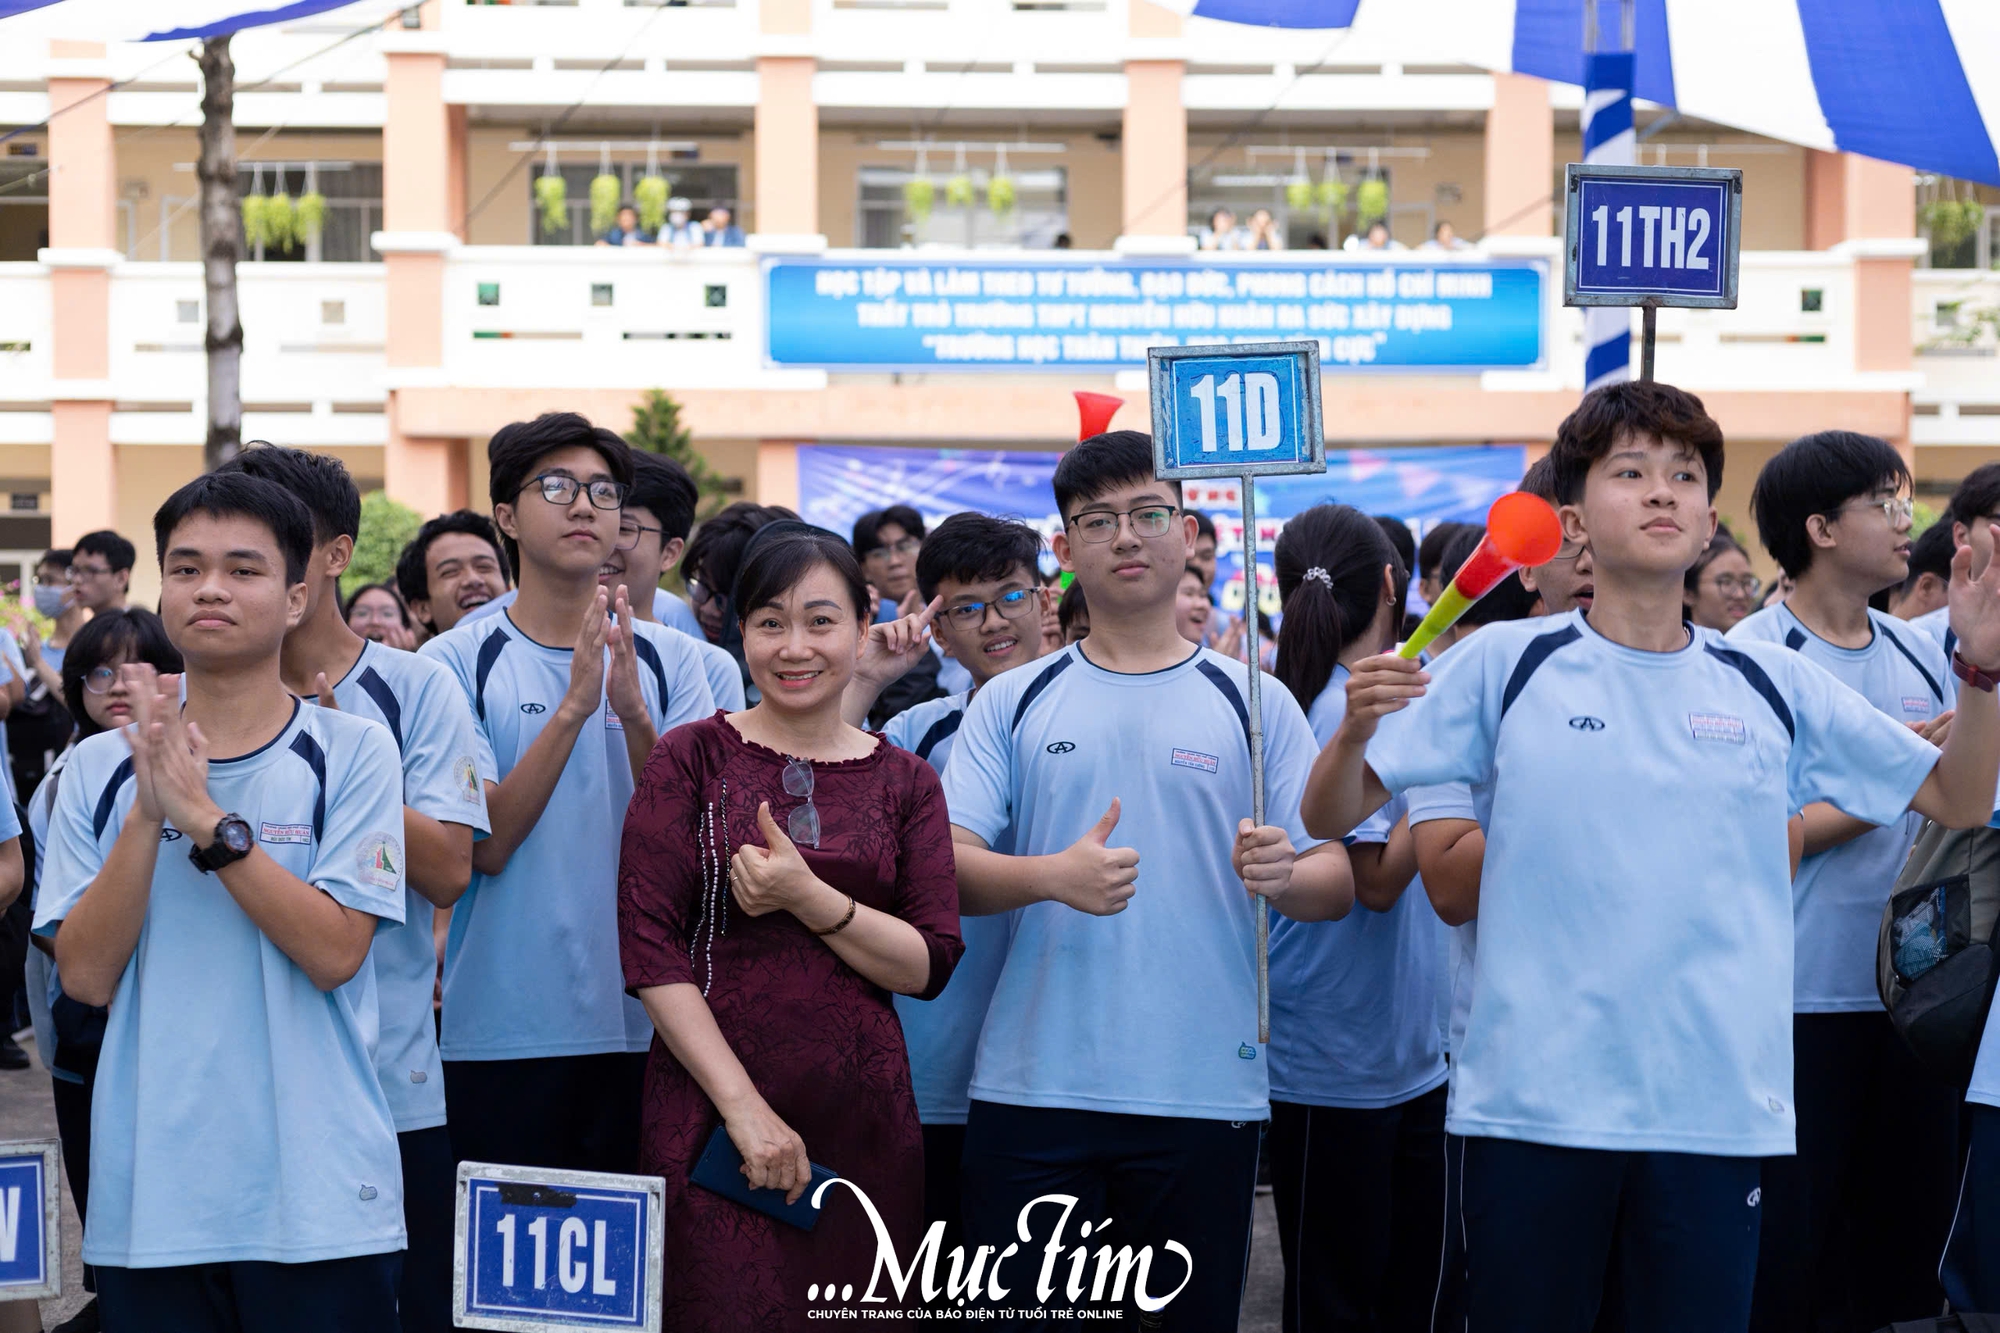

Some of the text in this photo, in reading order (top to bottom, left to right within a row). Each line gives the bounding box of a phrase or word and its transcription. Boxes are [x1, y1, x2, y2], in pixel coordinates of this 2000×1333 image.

[1591, 205, 1710, 270] 11TH2
[1190, 372, 1281, 452] 11D
[497, 1214, 617, 1296] 11CL
